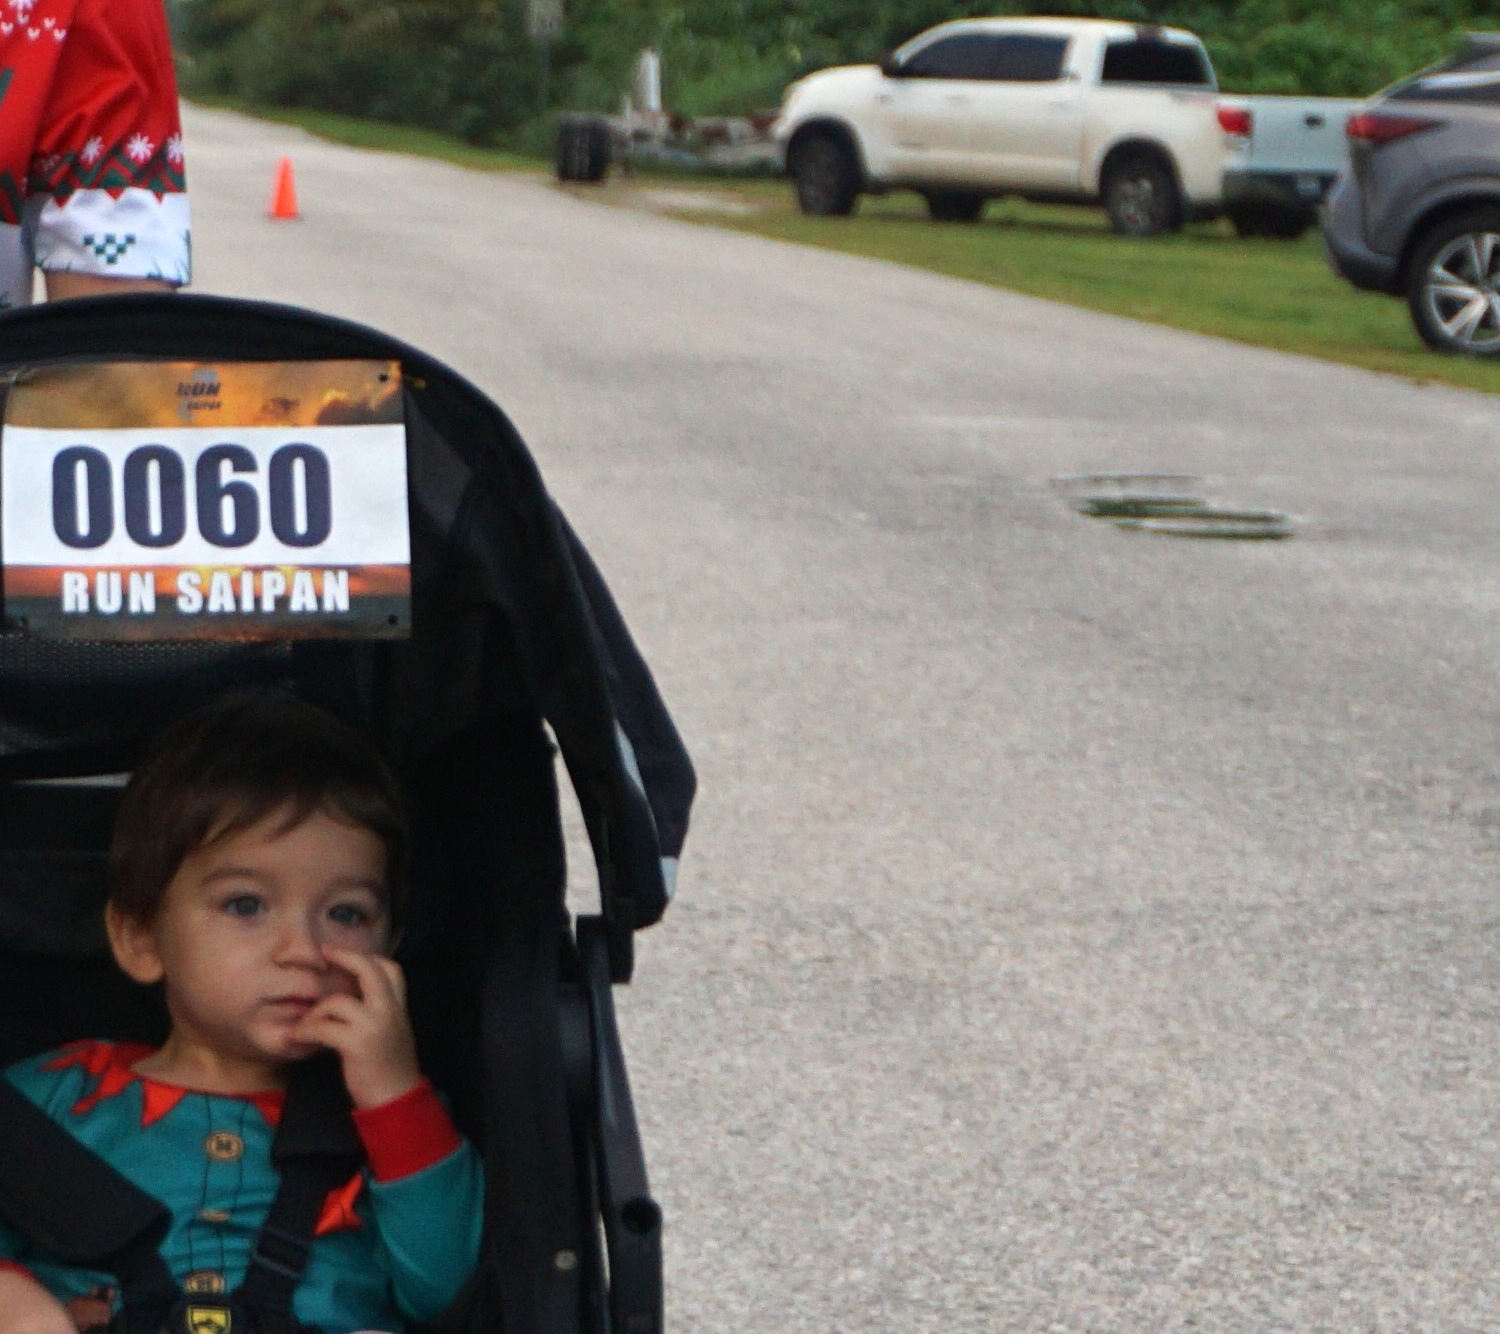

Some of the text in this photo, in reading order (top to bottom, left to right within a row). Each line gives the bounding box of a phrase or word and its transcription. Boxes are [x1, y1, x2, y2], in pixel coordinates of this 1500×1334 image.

[51, 442, 332, 550] 0060
[61, 569, 350, 614] RUN SAIPAN
